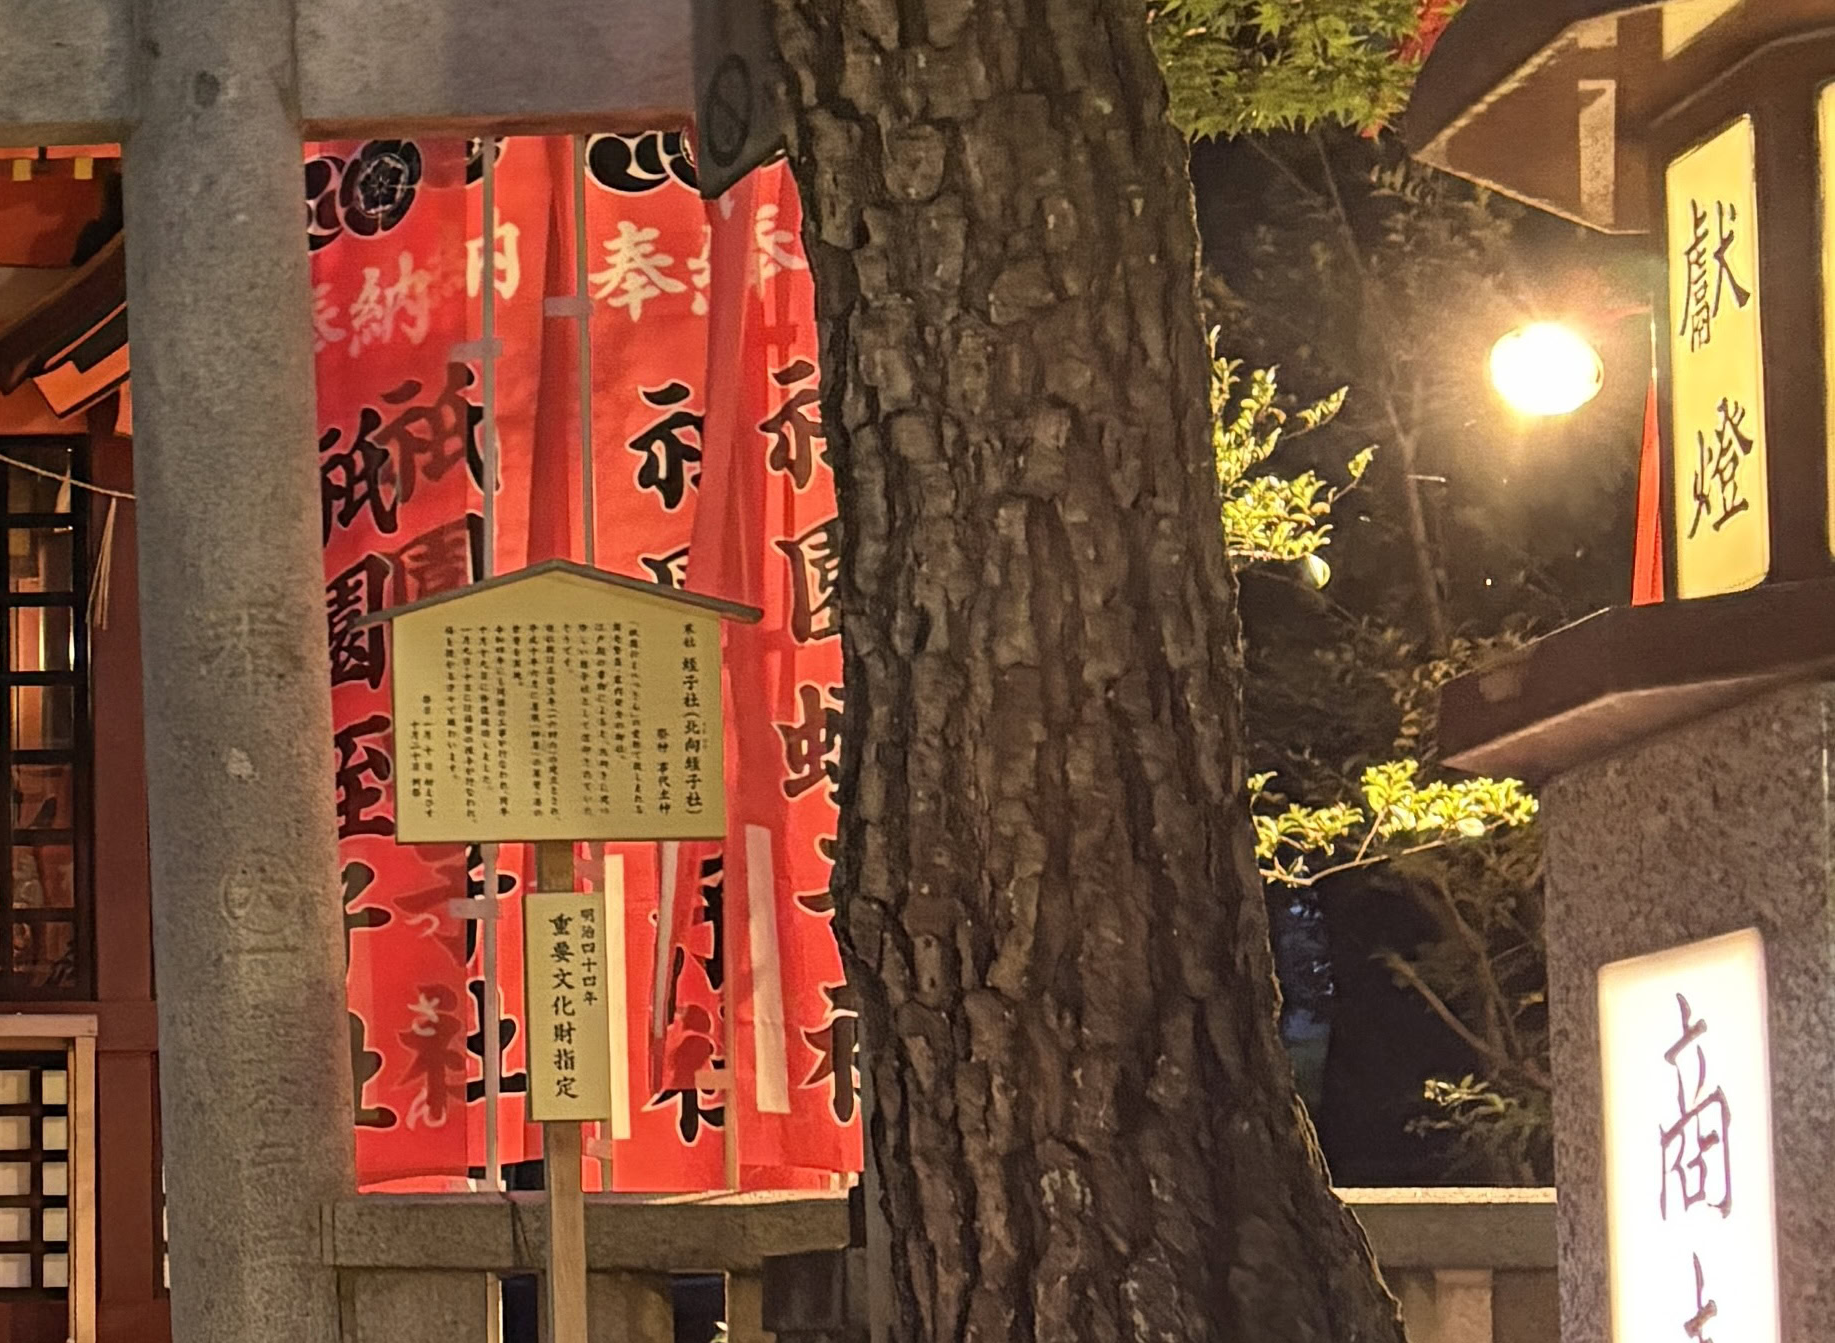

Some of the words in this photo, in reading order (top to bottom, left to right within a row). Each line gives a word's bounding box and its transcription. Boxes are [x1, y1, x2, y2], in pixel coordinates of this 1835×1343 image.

[548, 912, 580, 1100] 重要文化財指定
[579, 908, 598, 1006] 明治四十四年
